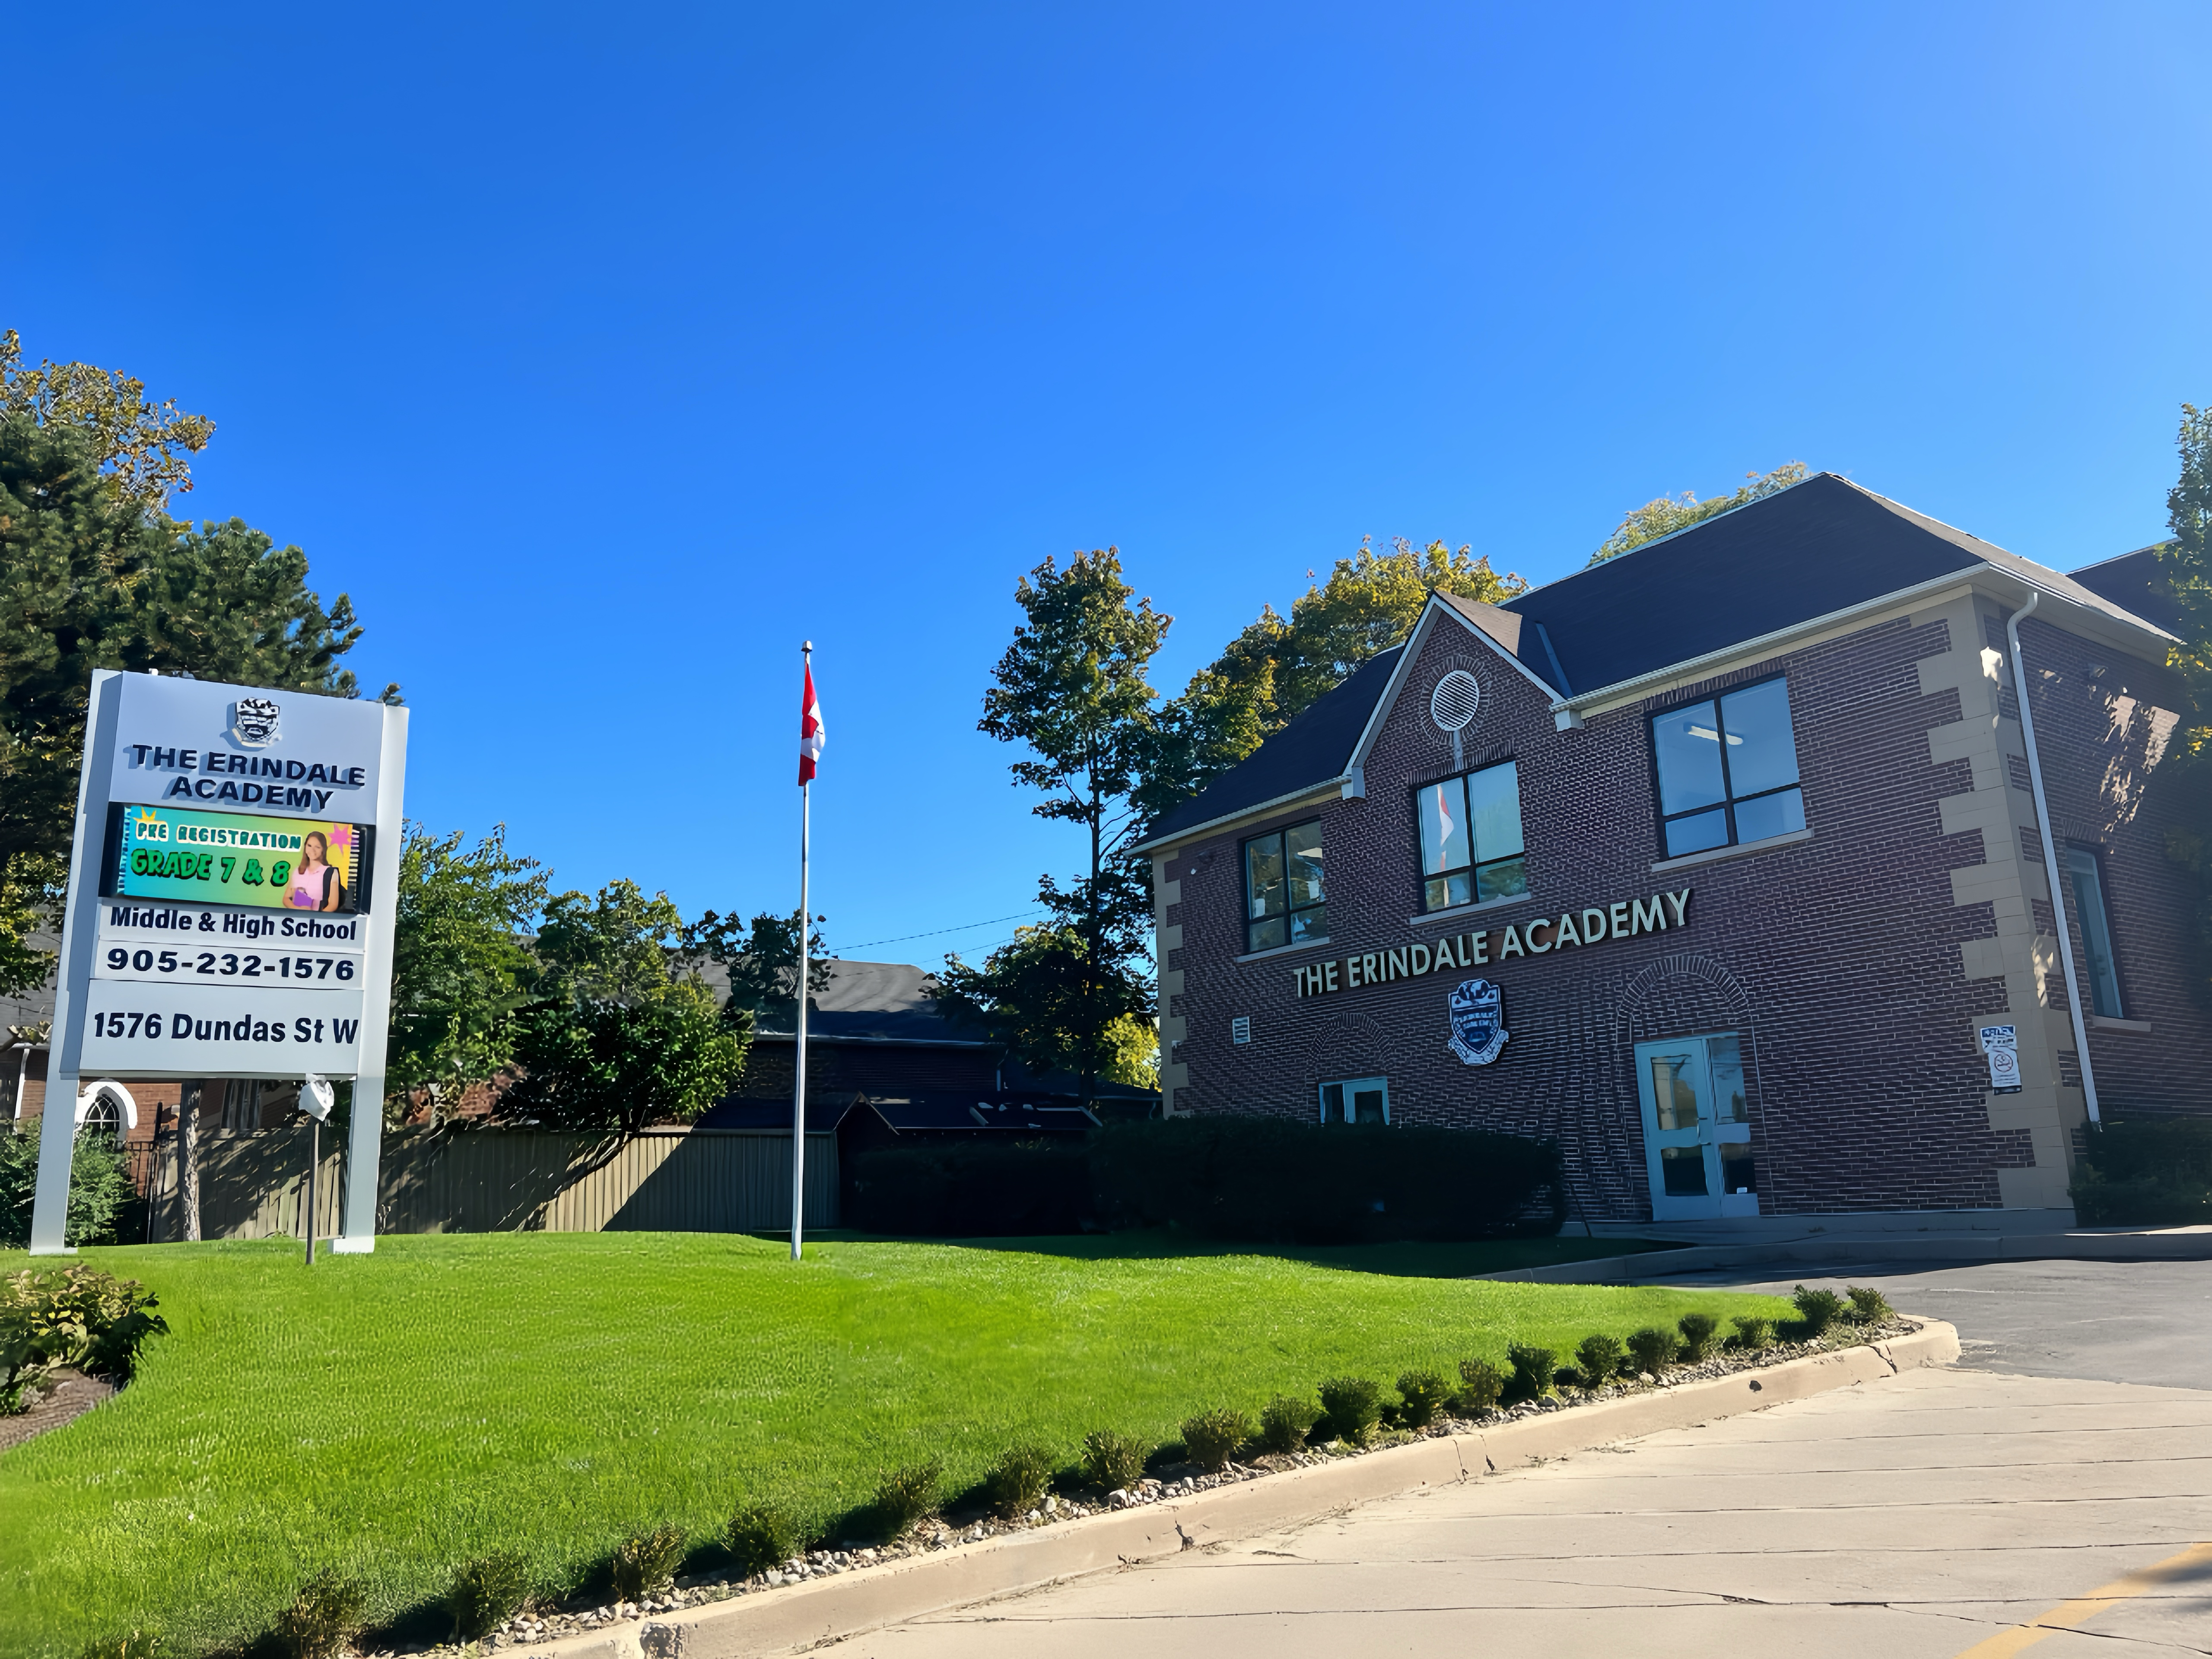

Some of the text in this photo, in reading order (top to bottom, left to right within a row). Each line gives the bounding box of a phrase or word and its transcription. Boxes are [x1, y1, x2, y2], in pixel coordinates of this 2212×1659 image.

[133, 744, 366, 787] THE ERINDALE
[170, 776, 334, 810] ACADEMY
[137, 822, 302, 850] PRE REGISTRATION
[131, 849, 291, 887] GRADE 7 & 8
[111, 906, 356, 941] Middle & High School
[1294, 888, 1691, 997] THE ERINDALE ACADEMY
[107, 948, 354, 981] 905-232-1576
[94, 1012, 359, 1045] 1576 Dundas St W
